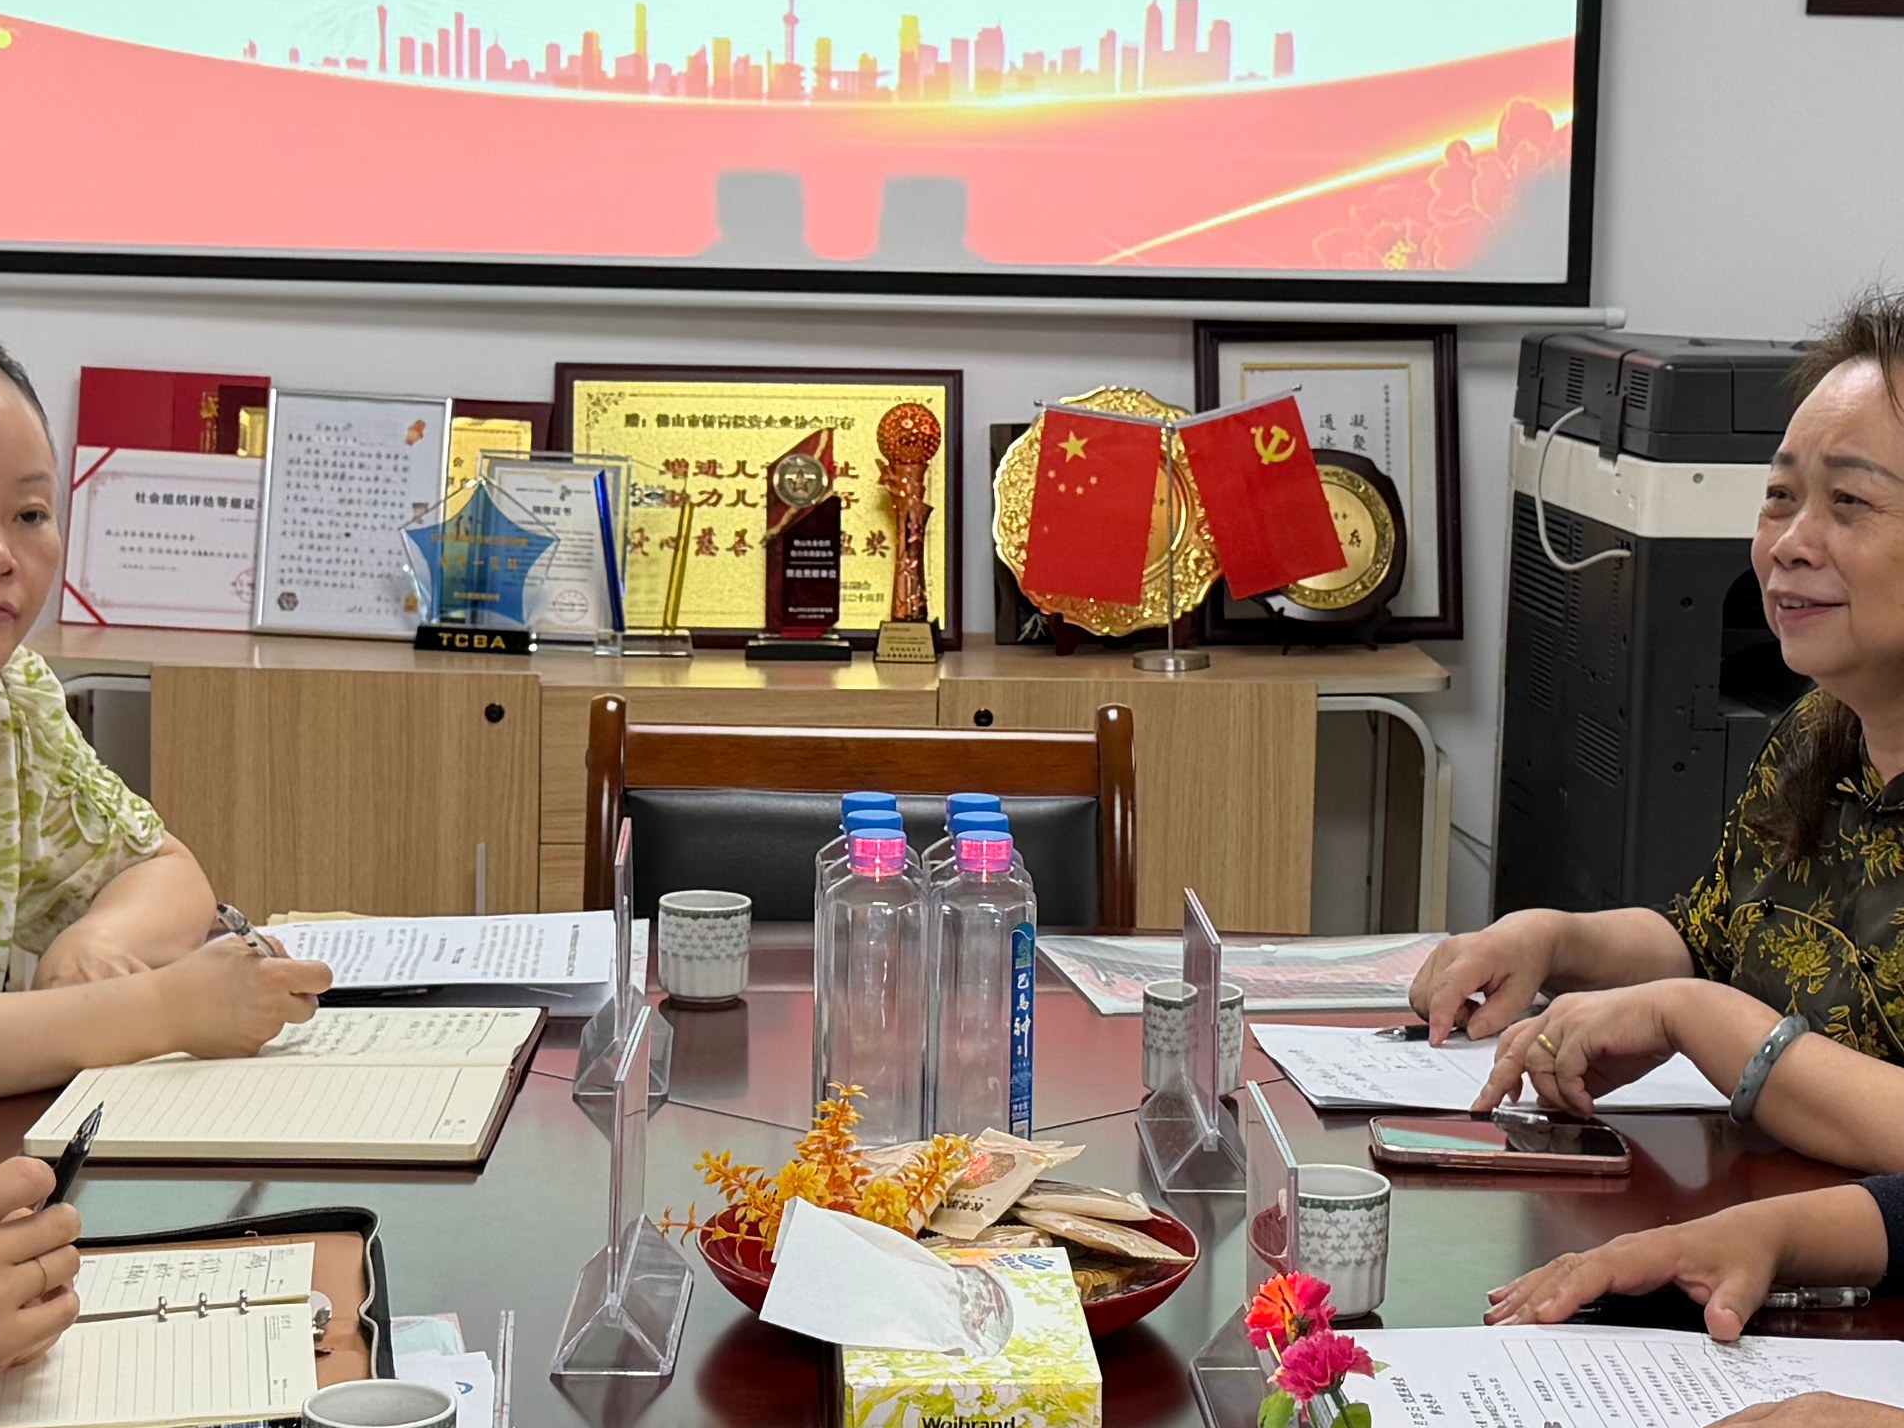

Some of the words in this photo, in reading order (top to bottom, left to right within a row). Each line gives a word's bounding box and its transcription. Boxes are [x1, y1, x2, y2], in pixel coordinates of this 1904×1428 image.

[135, 490, 262, 511] 社会组织评估等级证
[438, 631, 507, 650] TCBA
